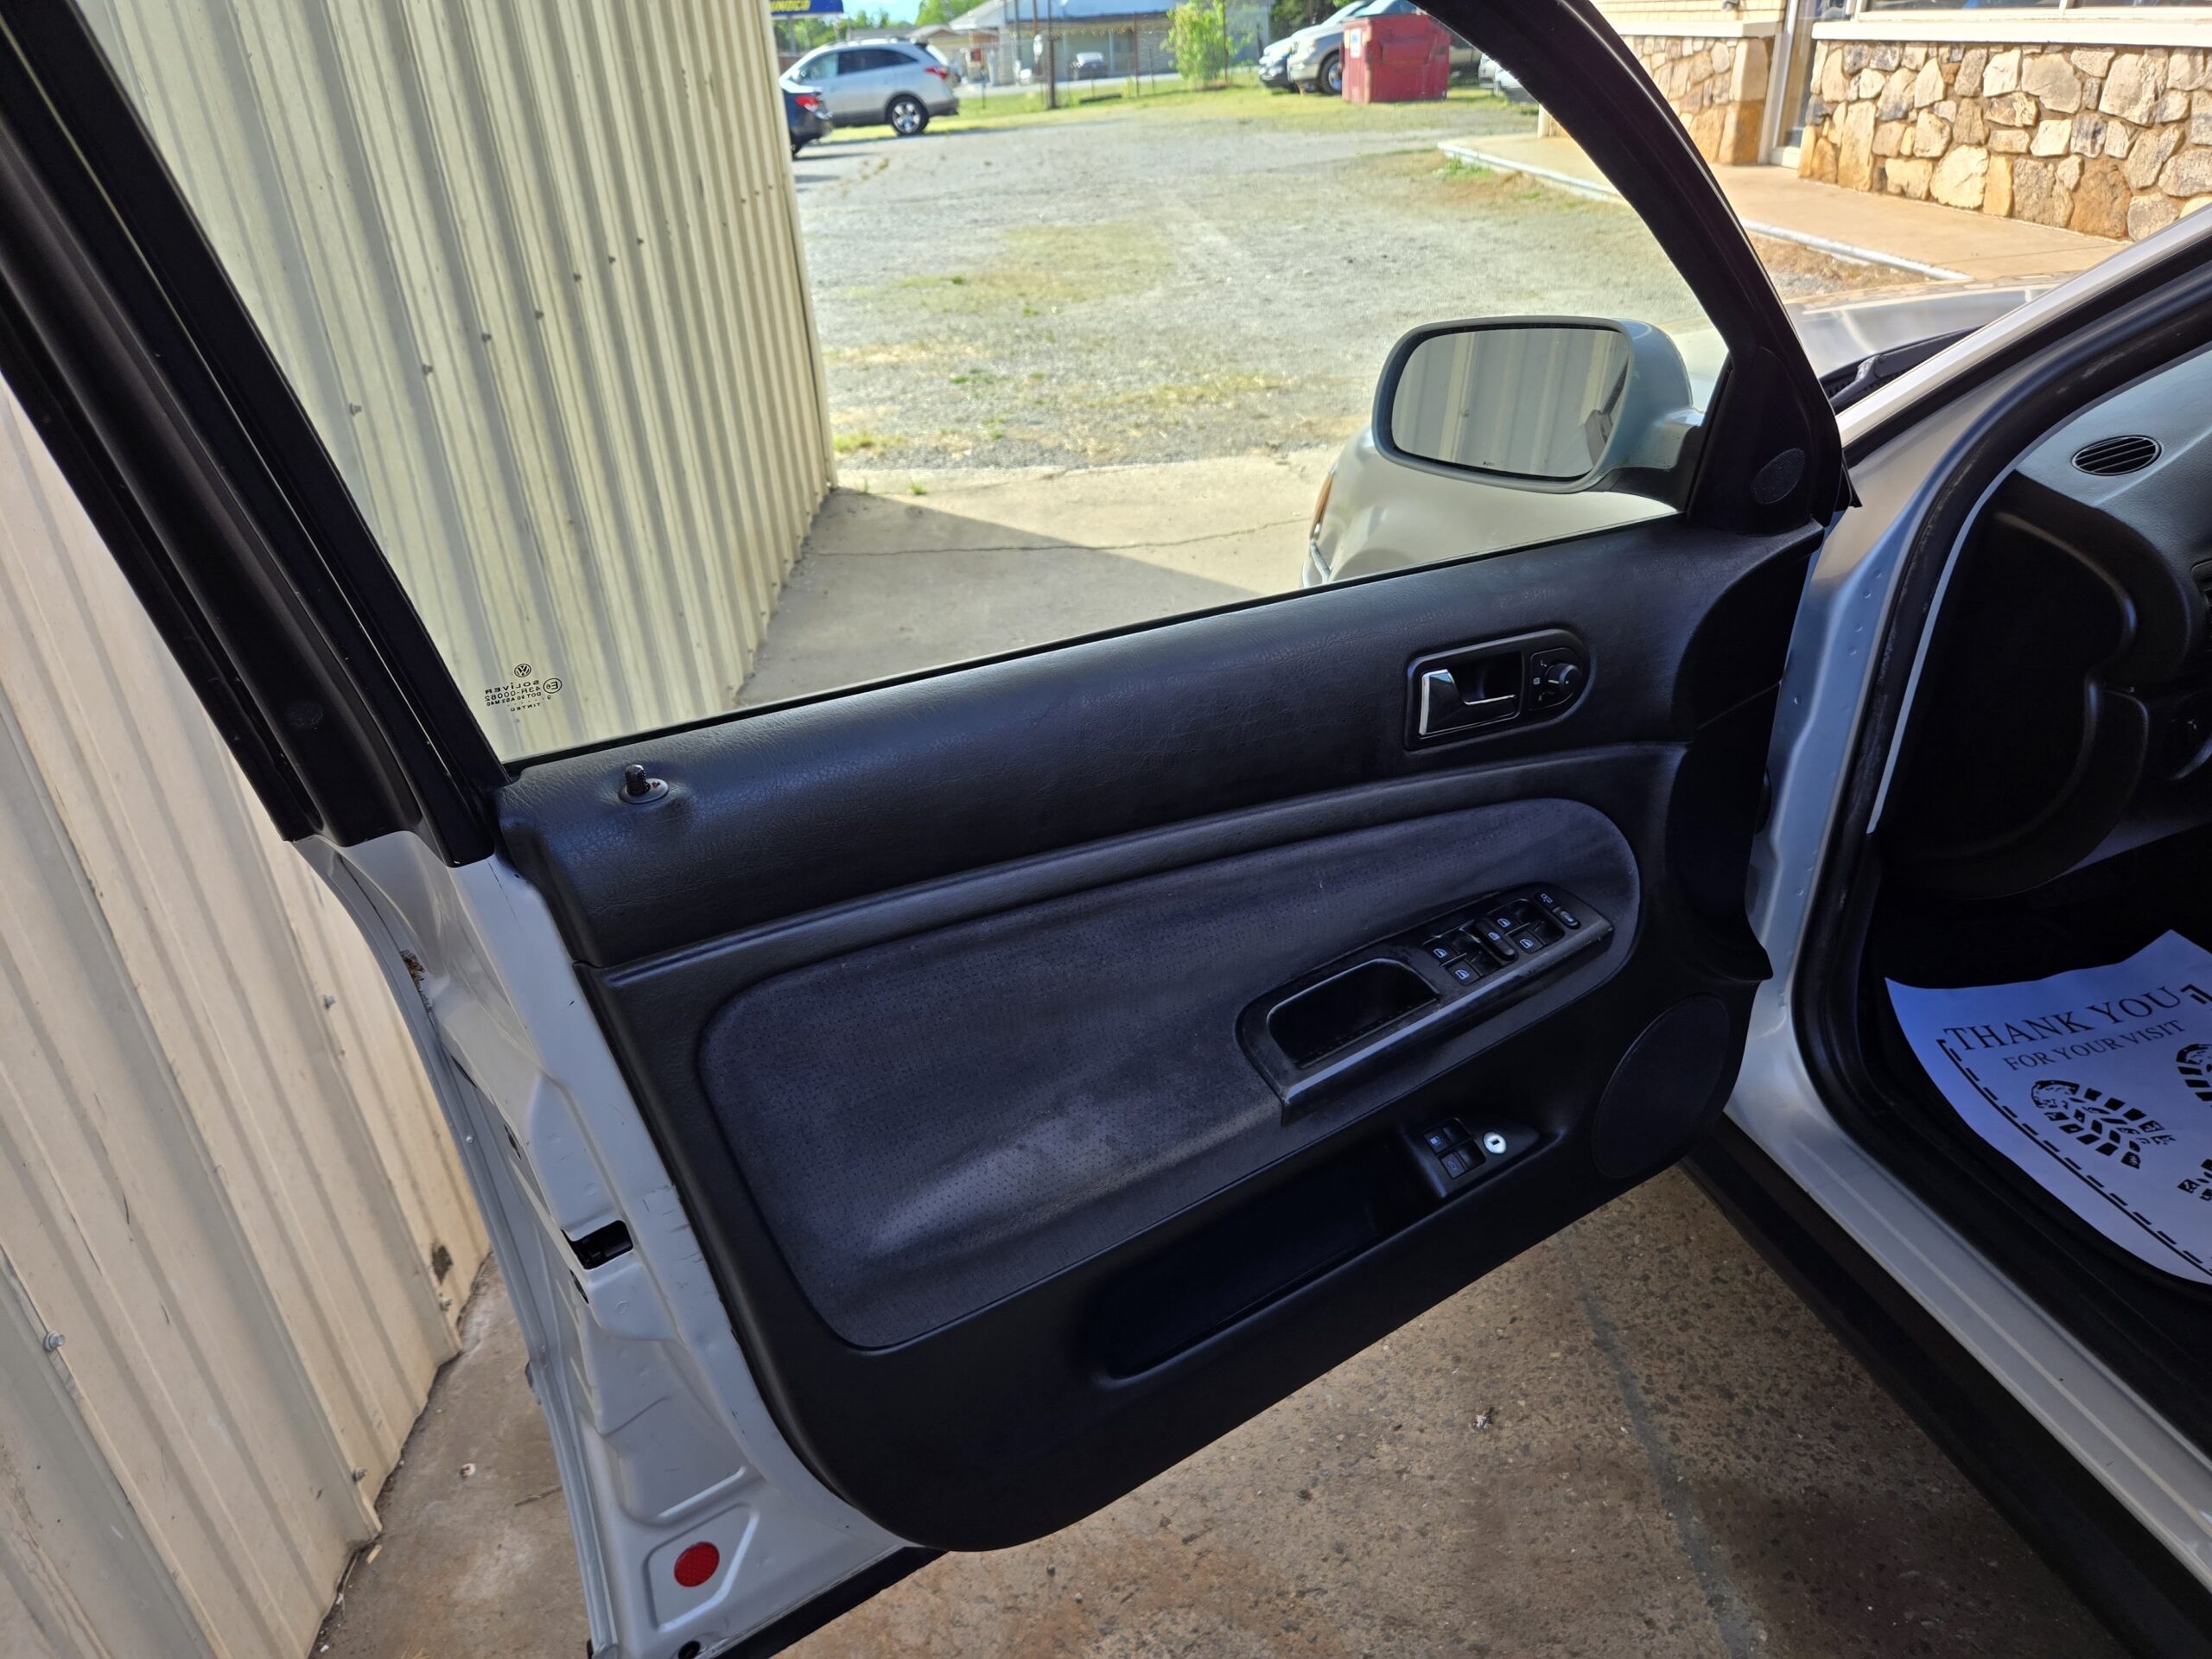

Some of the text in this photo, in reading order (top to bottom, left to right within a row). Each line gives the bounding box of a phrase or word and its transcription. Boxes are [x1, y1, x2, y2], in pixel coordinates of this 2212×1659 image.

[1943, 986, 2181, 1051] THANK YOU
[2002, 1020, 2185, 1071] FOR YOUR VISIT
